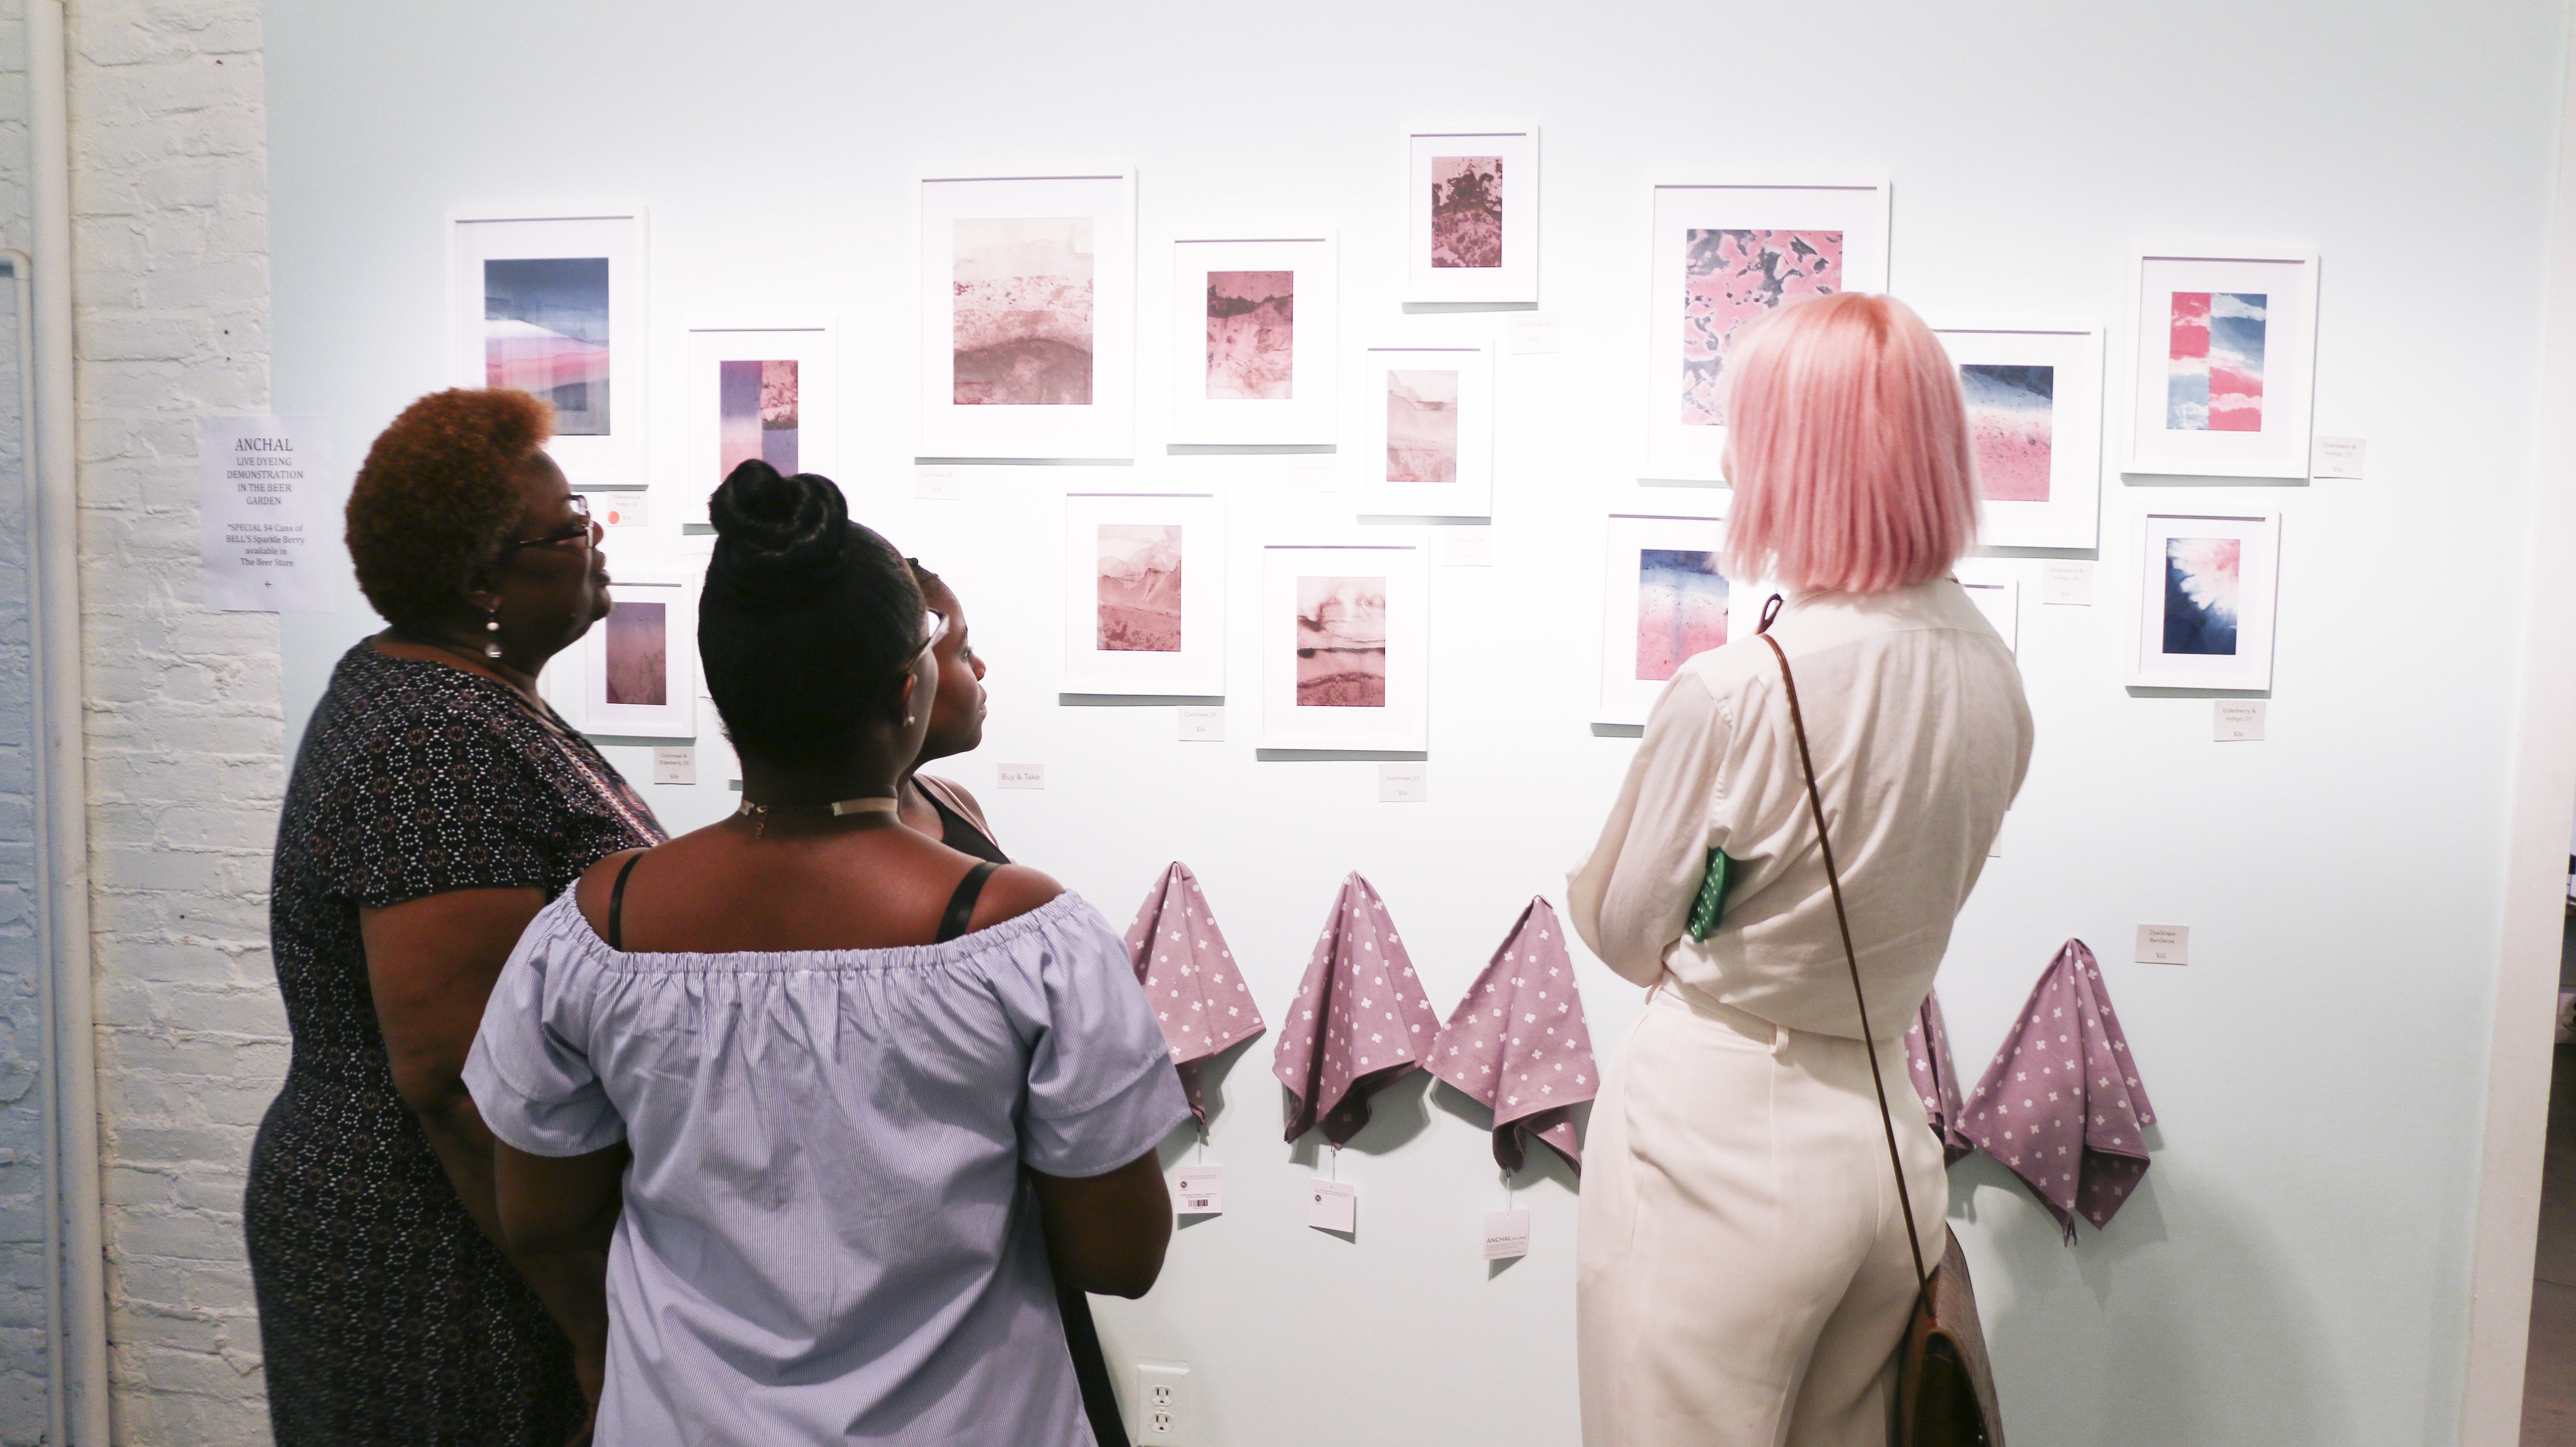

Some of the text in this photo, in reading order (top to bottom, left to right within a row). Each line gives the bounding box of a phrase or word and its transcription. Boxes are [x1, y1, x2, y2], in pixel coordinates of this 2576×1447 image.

[235, 438, 293, 451] ANCHAL
[237, 457, 291, 466] LIVE DYEING
[226, 470, 303, 478] DEMONSTRATION
[237, 483, 292, 492] IN THE BEER
[246, 496, 281, 505] GARDEN
[253, 535, 281, 545] Sparkle
[283, 536, 305, 545] Berry
[1002, 773, 1014, 782] Buy
[1487, 1235, 1511, 1243] ANCHAL
